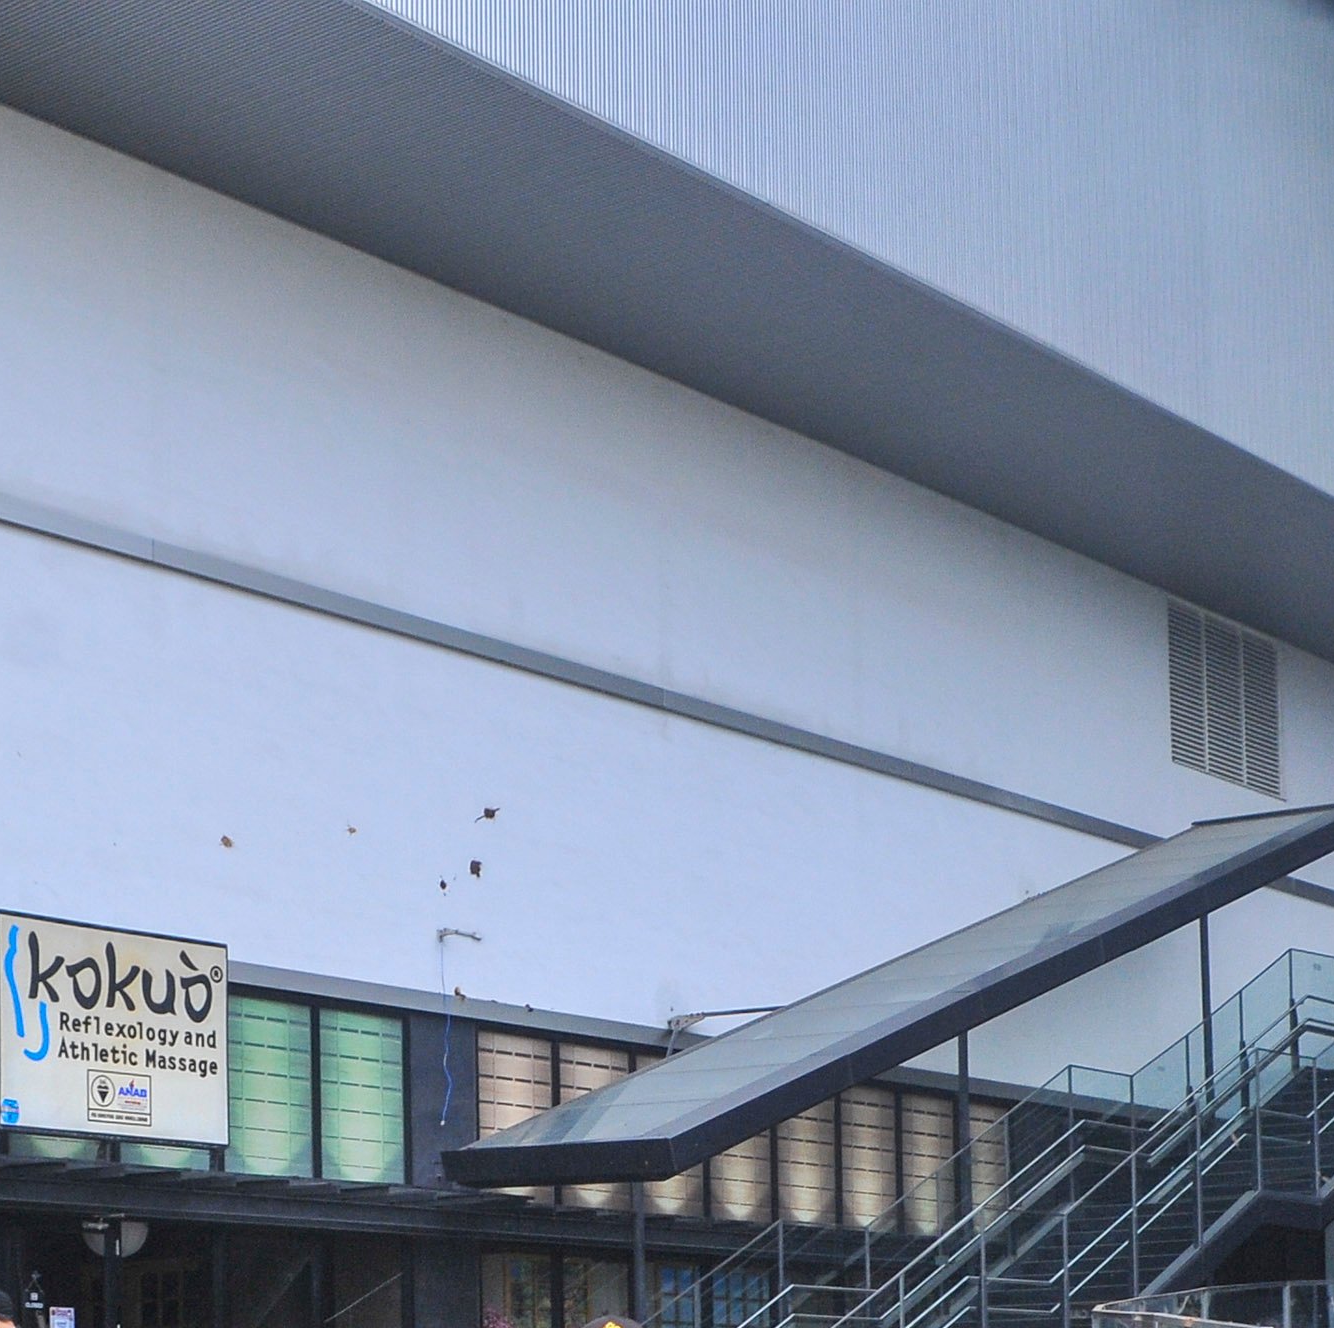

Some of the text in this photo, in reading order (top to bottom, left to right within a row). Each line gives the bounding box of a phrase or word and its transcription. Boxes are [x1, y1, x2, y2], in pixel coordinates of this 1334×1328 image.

[59, 1011, 217, 1049] Reflexology and
[57, 1036, 218, 1078] Athletic Massage
